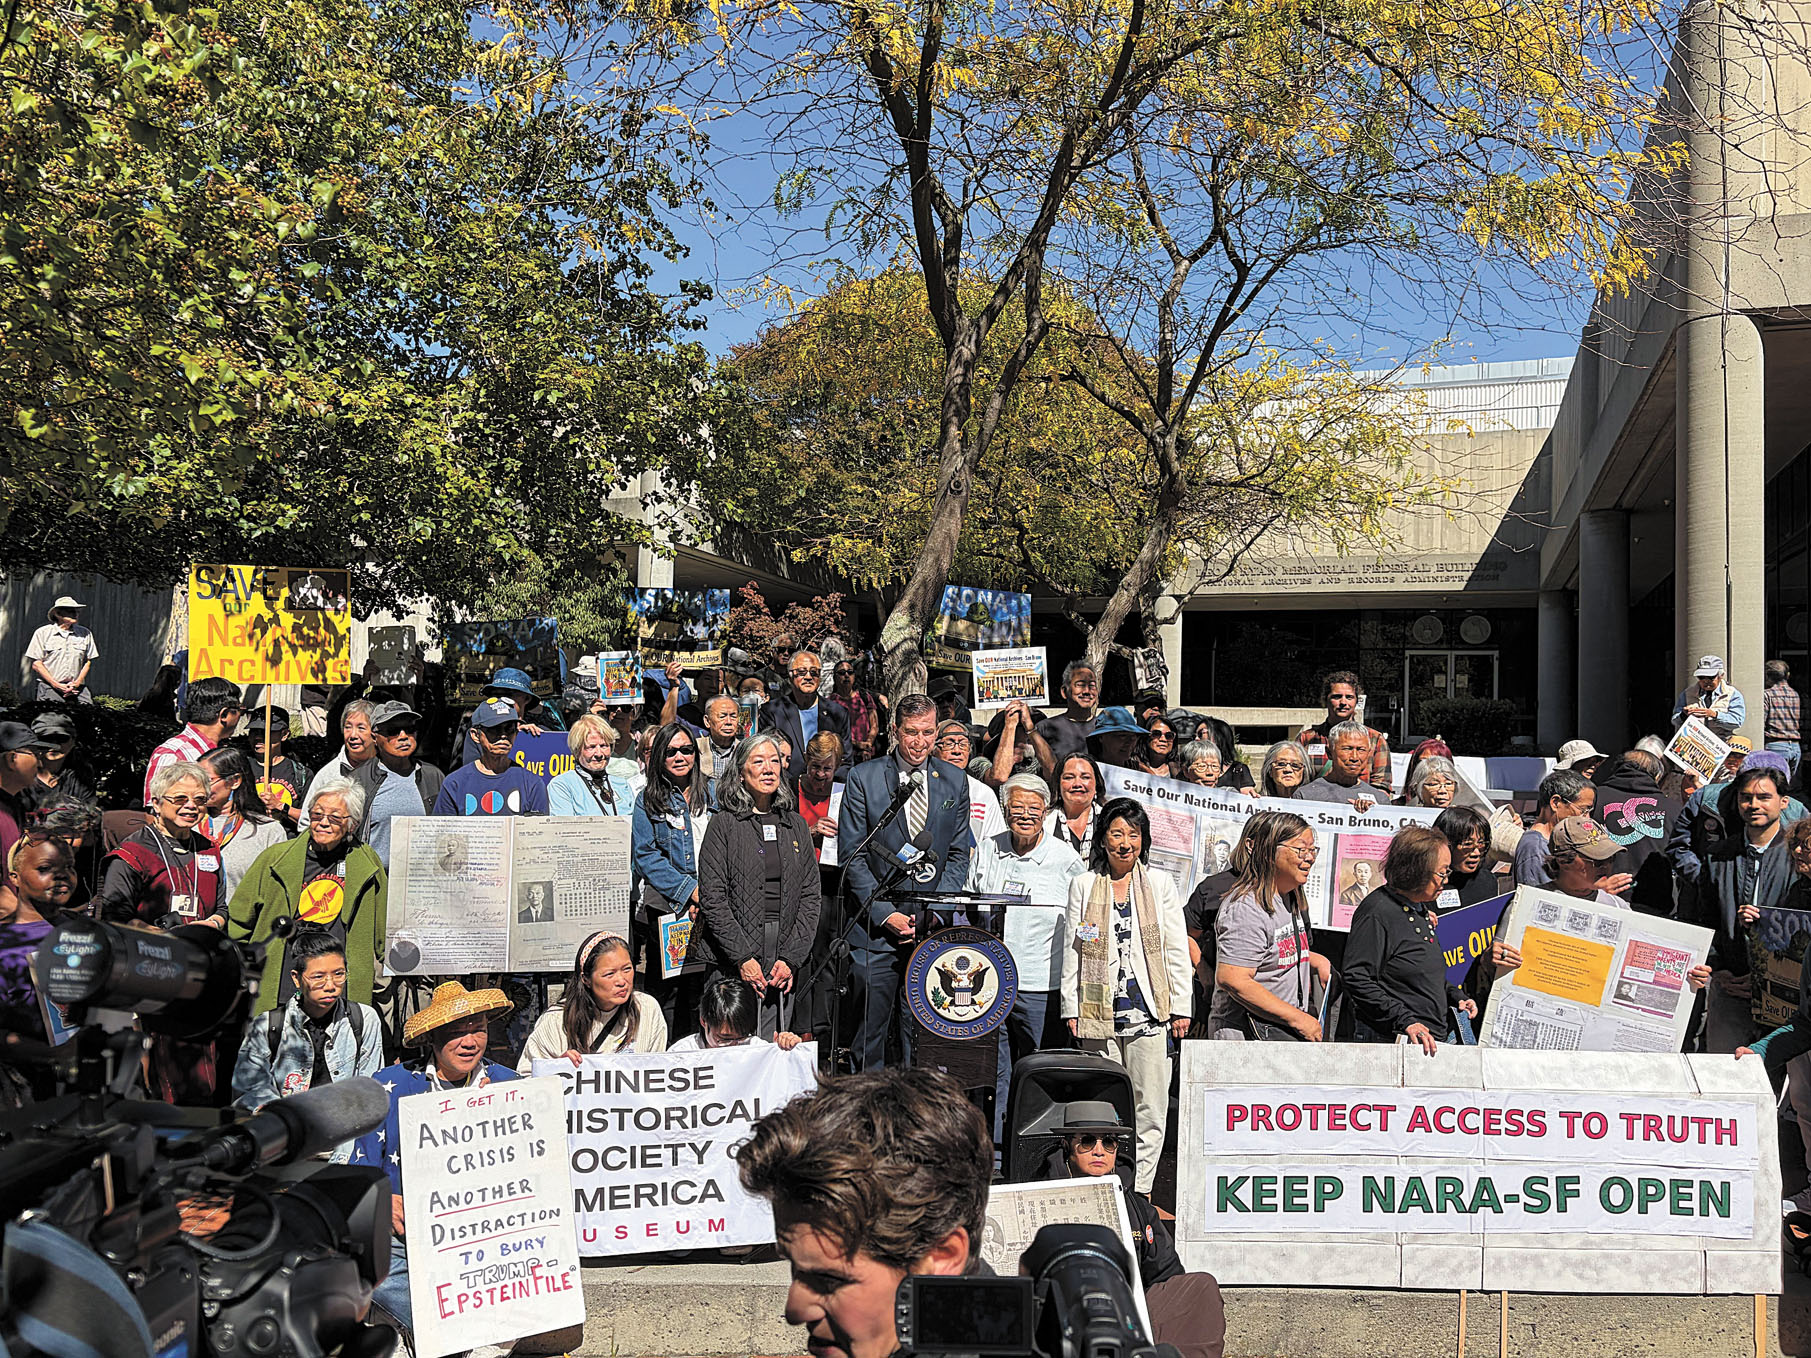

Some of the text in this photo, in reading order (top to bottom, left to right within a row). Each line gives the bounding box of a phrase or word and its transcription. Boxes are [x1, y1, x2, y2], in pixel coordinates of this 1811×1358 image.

[196, 565, 280, 601] SAVE
[1261, 577, 1312, 586] ARCHIVES
[1318, 577, 1341, 585] AND
[1348, 576, 1395, 584] RECORDS
[1281, 564, 1358, 576] MEMORIAL
[1362, 562, 1432, 574] FEDERAL
[223, 602, 250, 614] our
[208, 614, 331, 648] National
[192, 648, 350, 683] Archives
[696, 654, 719, 663] Archives
[939, 650, 971, 665] Save OUR
[1123, 780, 1153, 796] Save
[1157, 788, 1181, 802] Our
[1184, 793, 1241, 814] National
[1318, 813, 1343, 827] San
[1348, 815, 1395, 831] Bruno,
[911, 931, 1014, 985] HOUSE OF REPRESENTATIVES
[911, 985, 1014, 1036] UNITED STATES OF AMERICA
[1765, 1000, 1780, 1017] Save
[439, 1090, 524, 1113] I GET IT.
[567, 1098, 763, 1134] ISTORICAL
[418, 1112, 534, 1149] ANOTHER
[1226, 1103, 1738, 1146] PROTECT ACCESS TO TRUTH
[446, 1139, 546, 1175] CRISIS IS
[571, 1140, 713, 1173] OCIETY
[429, 1178, 533, 1213] ANOTHER
[575, 1179, 725, 1213] MERICA
[1216, 1175, 1731, 1218] KEEP NARA-SF OPEN
[431, 1208, 561, 1246] DISTRACTION
[582, 1218, 725, 1242] USEUM
[459, 1236, 546, 1265] TO BURY
